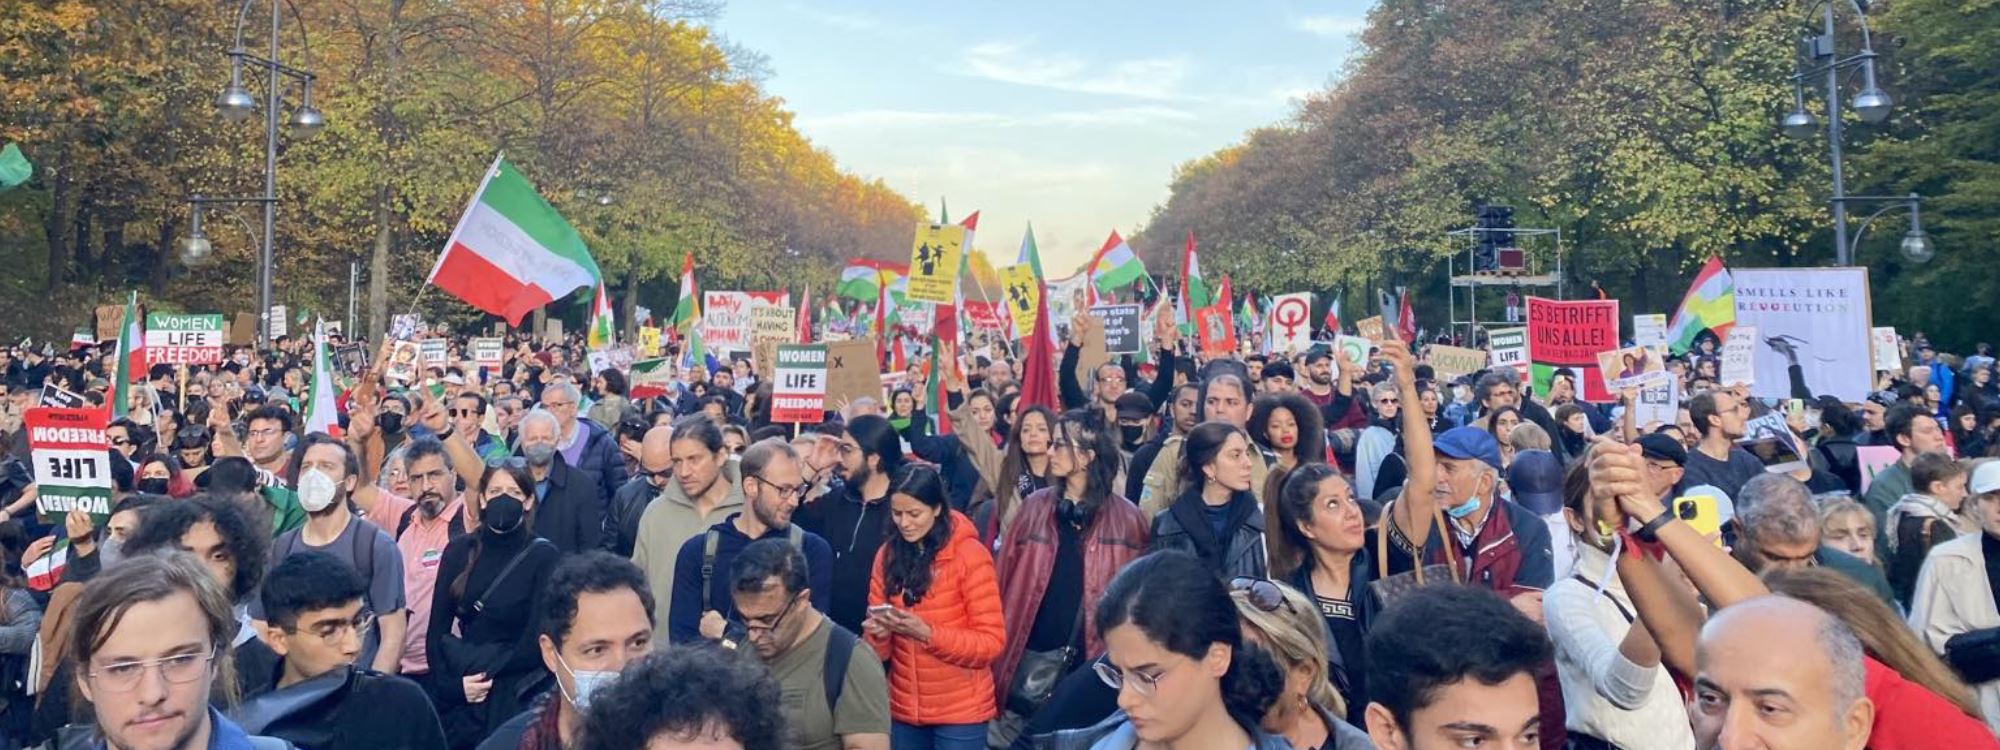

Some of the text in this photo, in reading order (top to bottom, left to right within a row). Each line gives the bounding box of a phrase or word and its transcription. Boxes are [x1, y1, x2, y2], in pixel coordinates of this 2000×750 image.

[1737, 288, 1849, 298] SMELLS LIKE
[1109, 308, 1135, 316] state
[1531, 303, 1613, 324] ES BETRIFFT
[155, 316, 217, 330] WOMEN
[756, 321, 788, 333] HAVING
[168, 332, 206, 346] LIFE
[1537, 325, 1605, 346] UNS ALLE!
[146, 347, 222, 363] FREEDOM
[779, 350, 825, 363] WOMEN
[1500, 350, 1519, 362] LIFE
[785, 374, 816, 388] LIFE
[774, 398, 824, 409] FREEDOM
[33, 427, 106, 444] FREEDOM
[48, 457, 97, 479] LIFE
[41, 495, 109, 513] WOMEN
